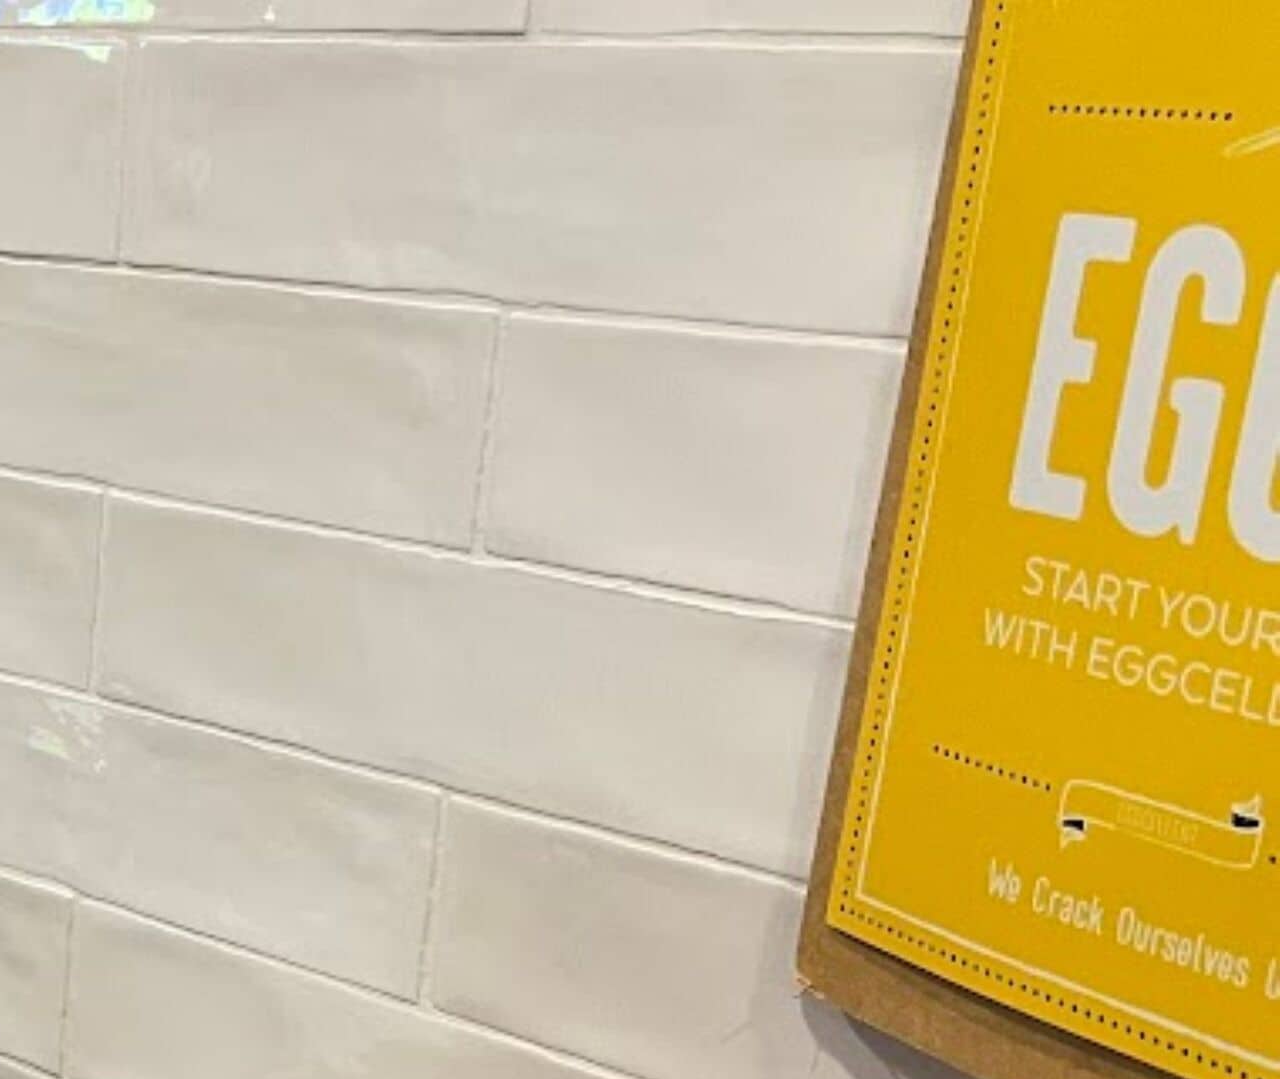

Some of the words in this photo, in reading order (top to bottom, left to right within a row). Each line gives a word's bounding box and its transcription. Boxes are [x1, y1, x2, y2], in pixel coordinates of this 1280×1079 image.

[984, 606, 1079, 671] WITH
[1021, 555, 1151, 622] START
[1157, 586, 1279, 656] YOUR
[988, 856, 1022, 904] We
[1031, 876, 1105, 936] Crack
[1116, 905, 1251, 990] Ourselves
